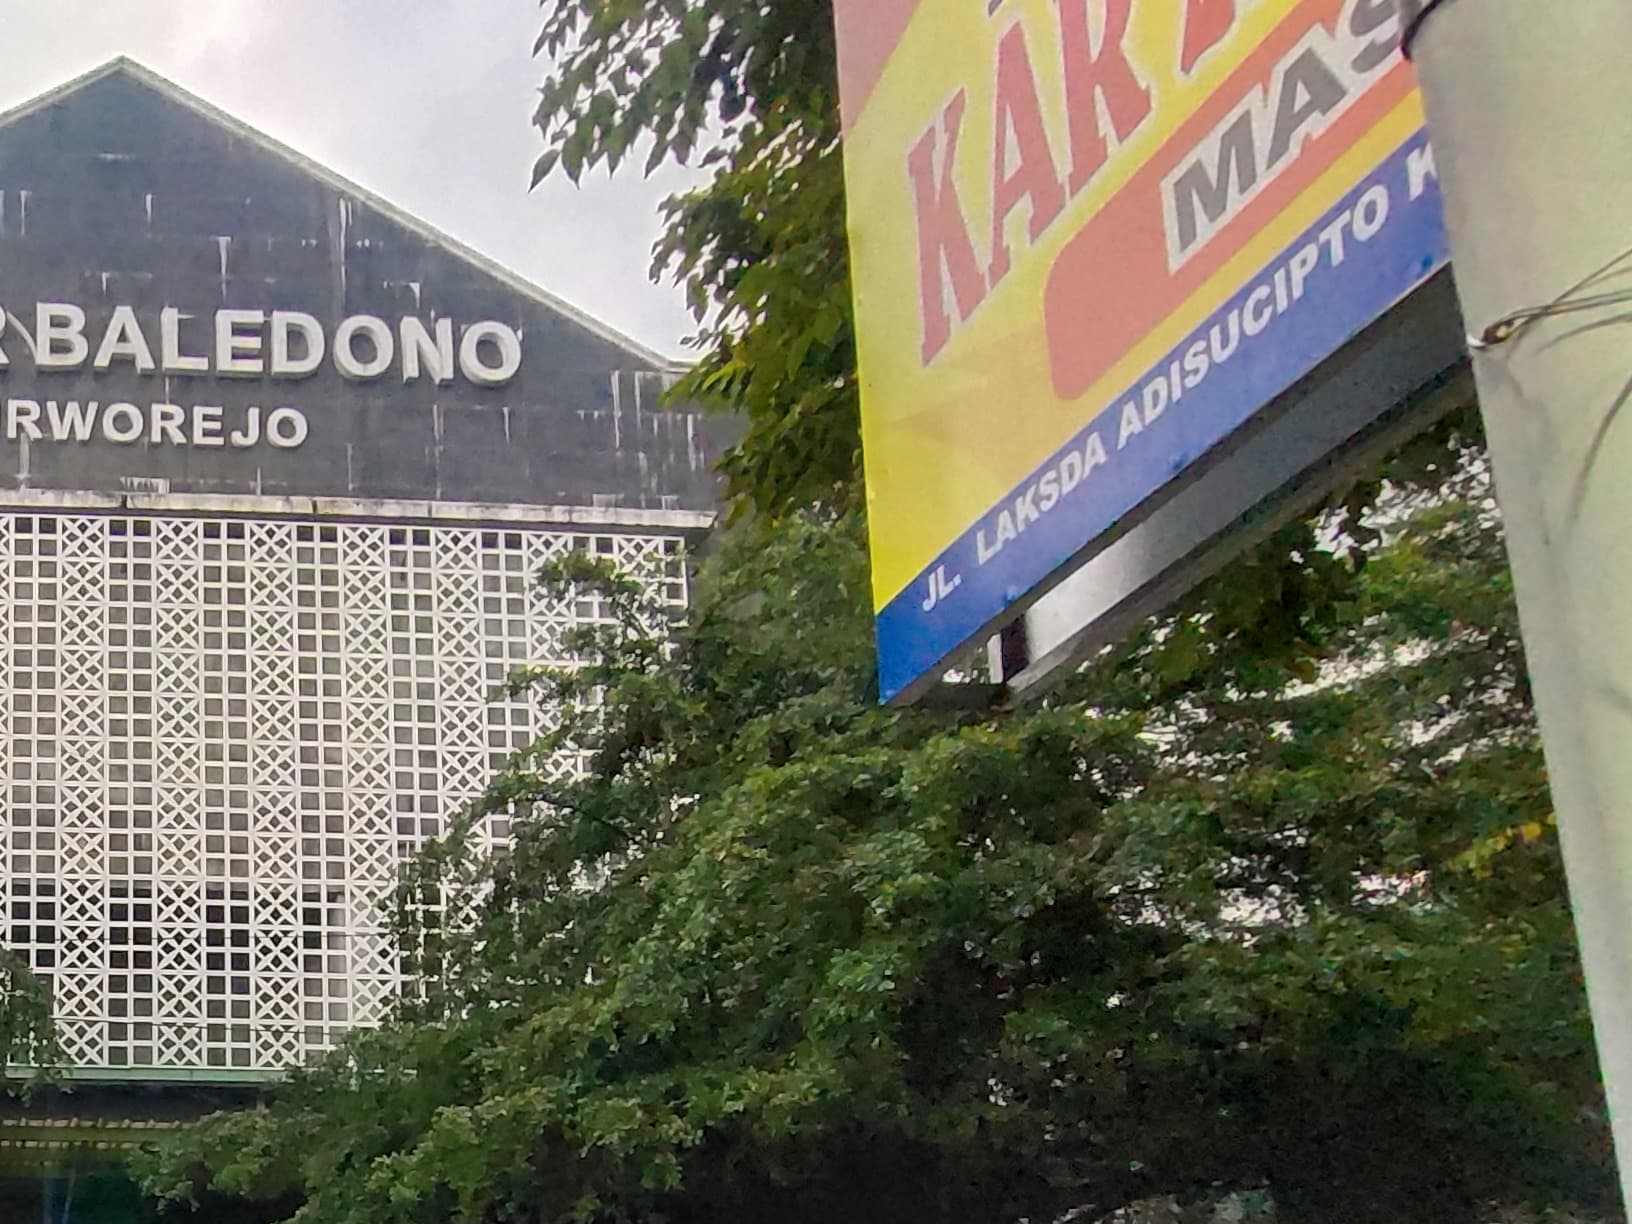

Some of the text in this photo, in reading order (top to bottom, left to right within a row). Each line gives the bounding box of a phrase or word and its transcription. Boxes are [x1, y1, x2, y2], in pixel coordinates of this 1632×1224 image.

[33, 300, 523, 387] BALEDONO
[922, 563, 963, 612] JL.
[975, 431, 1109, 566] LAKSDA
[1116, 184, 1389, 451] ADISUCIPTO
